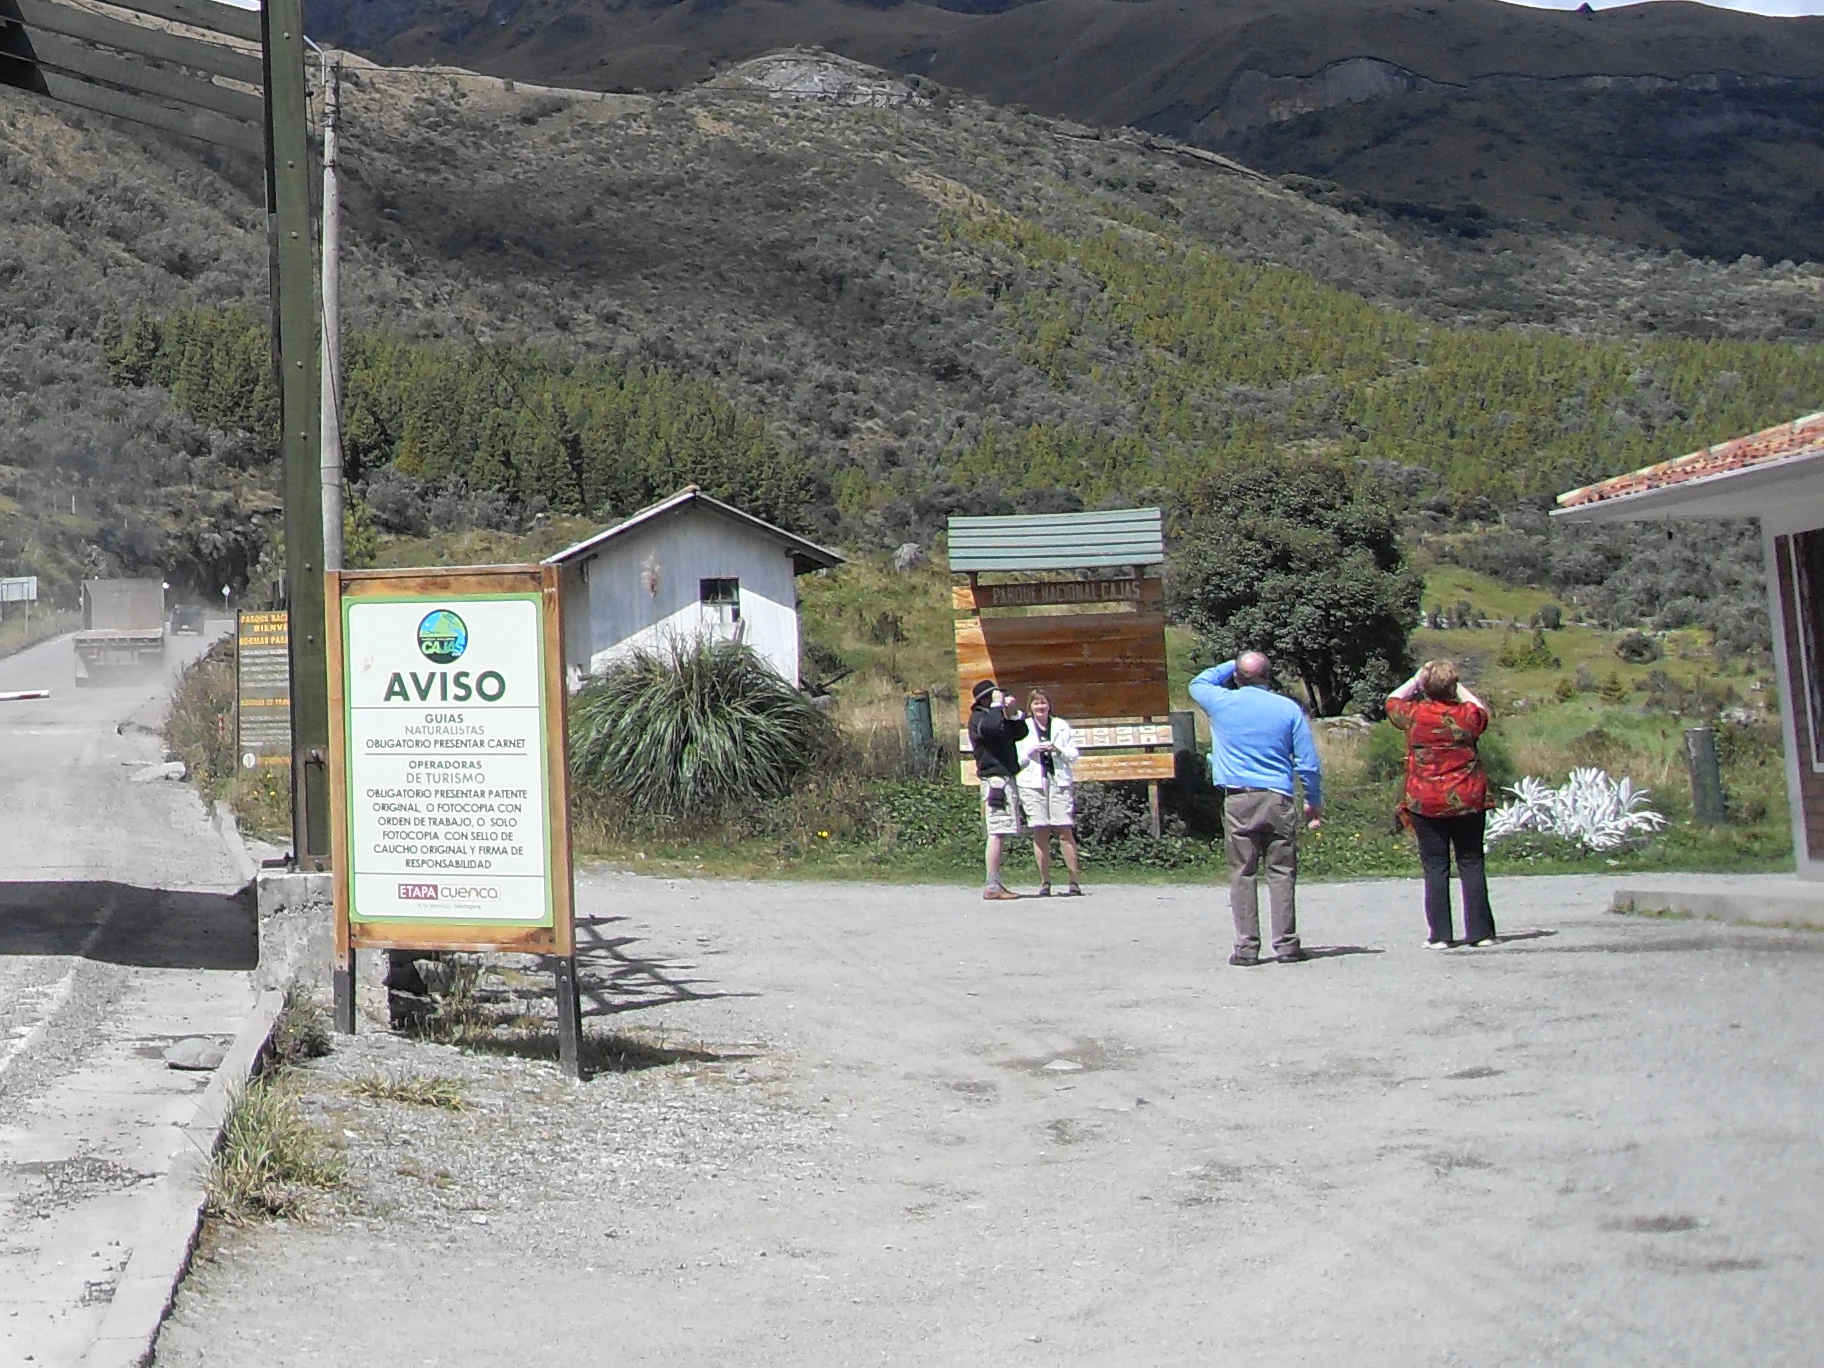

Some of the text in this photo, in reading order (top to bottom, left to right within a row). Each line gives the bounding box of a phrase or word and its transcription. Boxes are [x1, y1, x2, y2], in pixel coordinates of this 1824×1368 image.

[992, 581, 1141, 605] PARQUE NACIONAL CAJAS
[421, 641, 465, 655] CAJAS
[383, 670, 506, 702] AVISO
[424, 713, 464, 724] GUIAS
[405, 725, 485, 735] NATURALISTAS
[366, 738, 526, 749] OBLIGATORIO PRESENTAR CARNET
[408, 760, 482, 770] OPERADORAS
[406, 773, 485, 784] DE TURISMO
[366, 789, 527, 800] OBLIGATORIO PRESENTAR PATENTE
[426, 803, 434, 813] O
[437, 803, 495, 813] FOTOCOPIA
[497, 803, 522, 813] CON
[378, 817, 517, 828] ORDEN DE TRABAJO, O SOLO
[382, 830, 514, 841] FOTOCOPIA CON SELLO DE
[373, 844, 524, 856] CAUCHO ORIGINAL Y FIRMA DE
[405, 859, 492, 869] RESPONSABILIDAD
[400, 885, 498, 899] ETAPA cuenca
